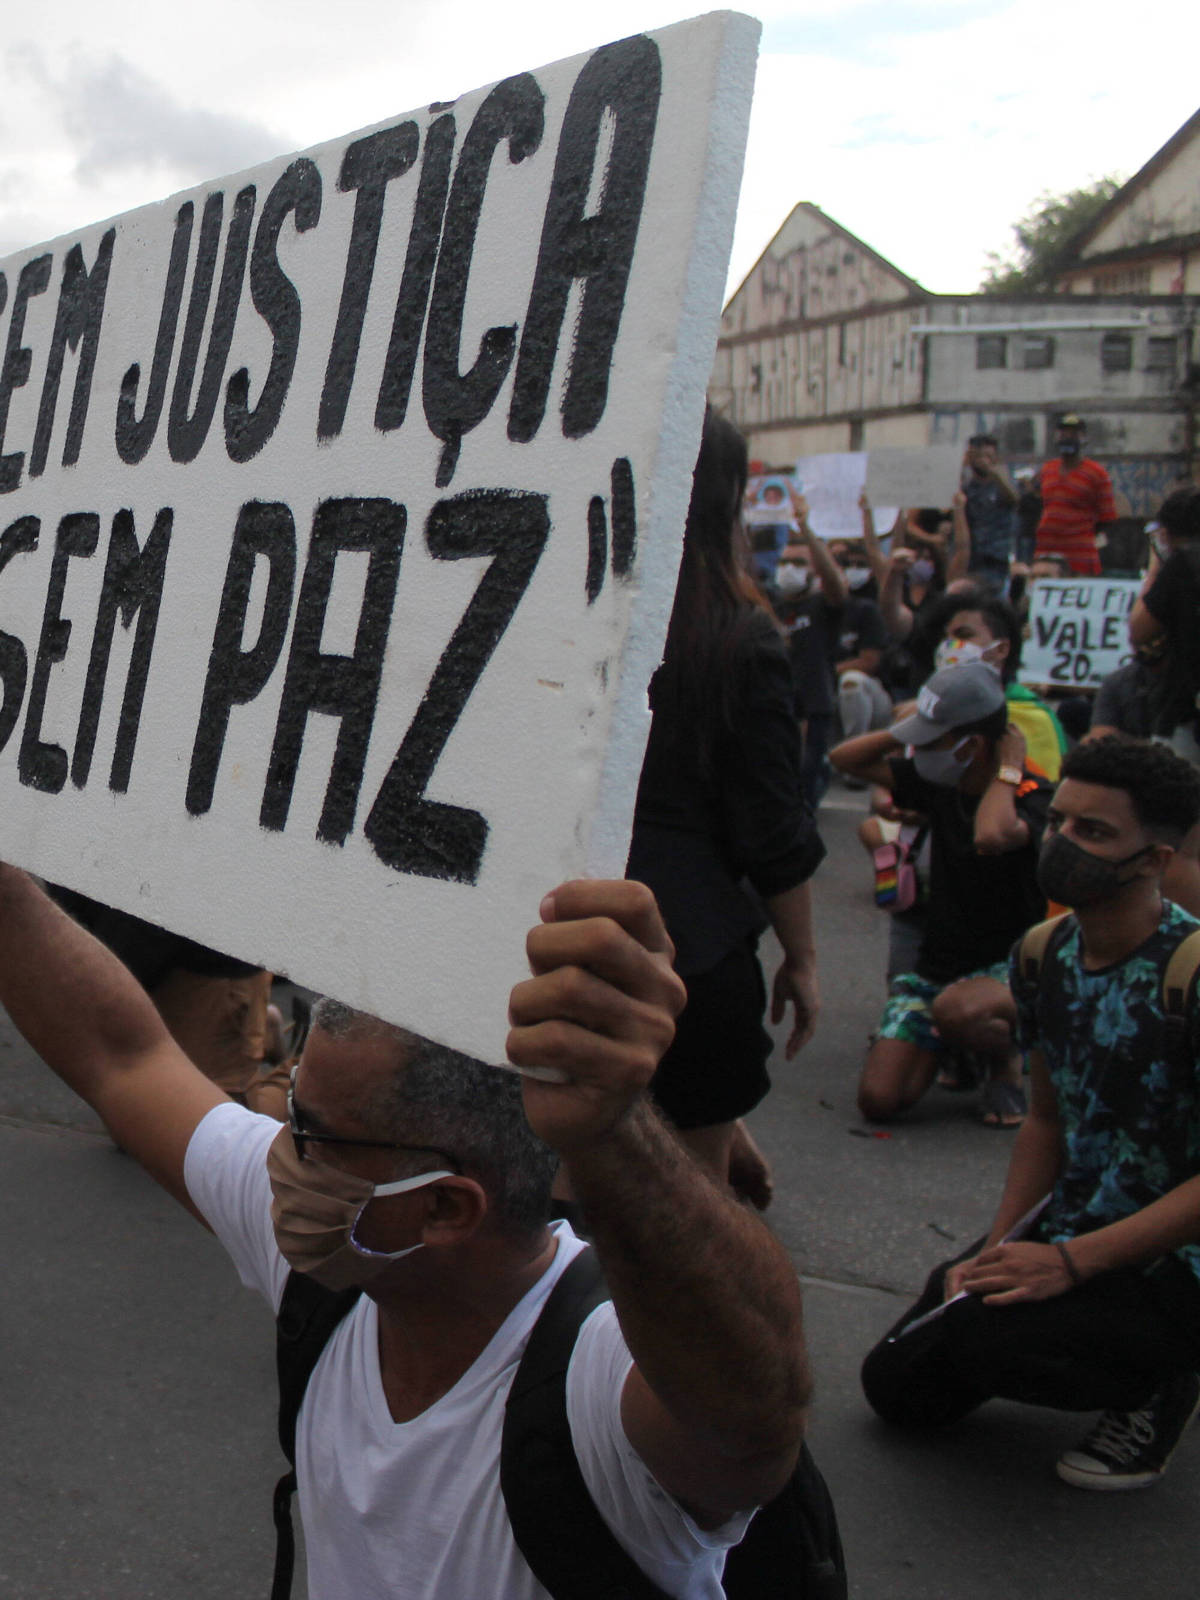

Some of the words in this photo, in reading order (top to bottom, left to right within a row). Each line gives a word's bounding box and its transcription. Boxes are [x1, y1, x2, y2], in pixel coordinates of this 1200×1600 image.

[115, 33, 663, 489] JUSTIÇA
[1037, 585, 1094, 610] TEU
[1035, 615, 1121, 651] VALE
